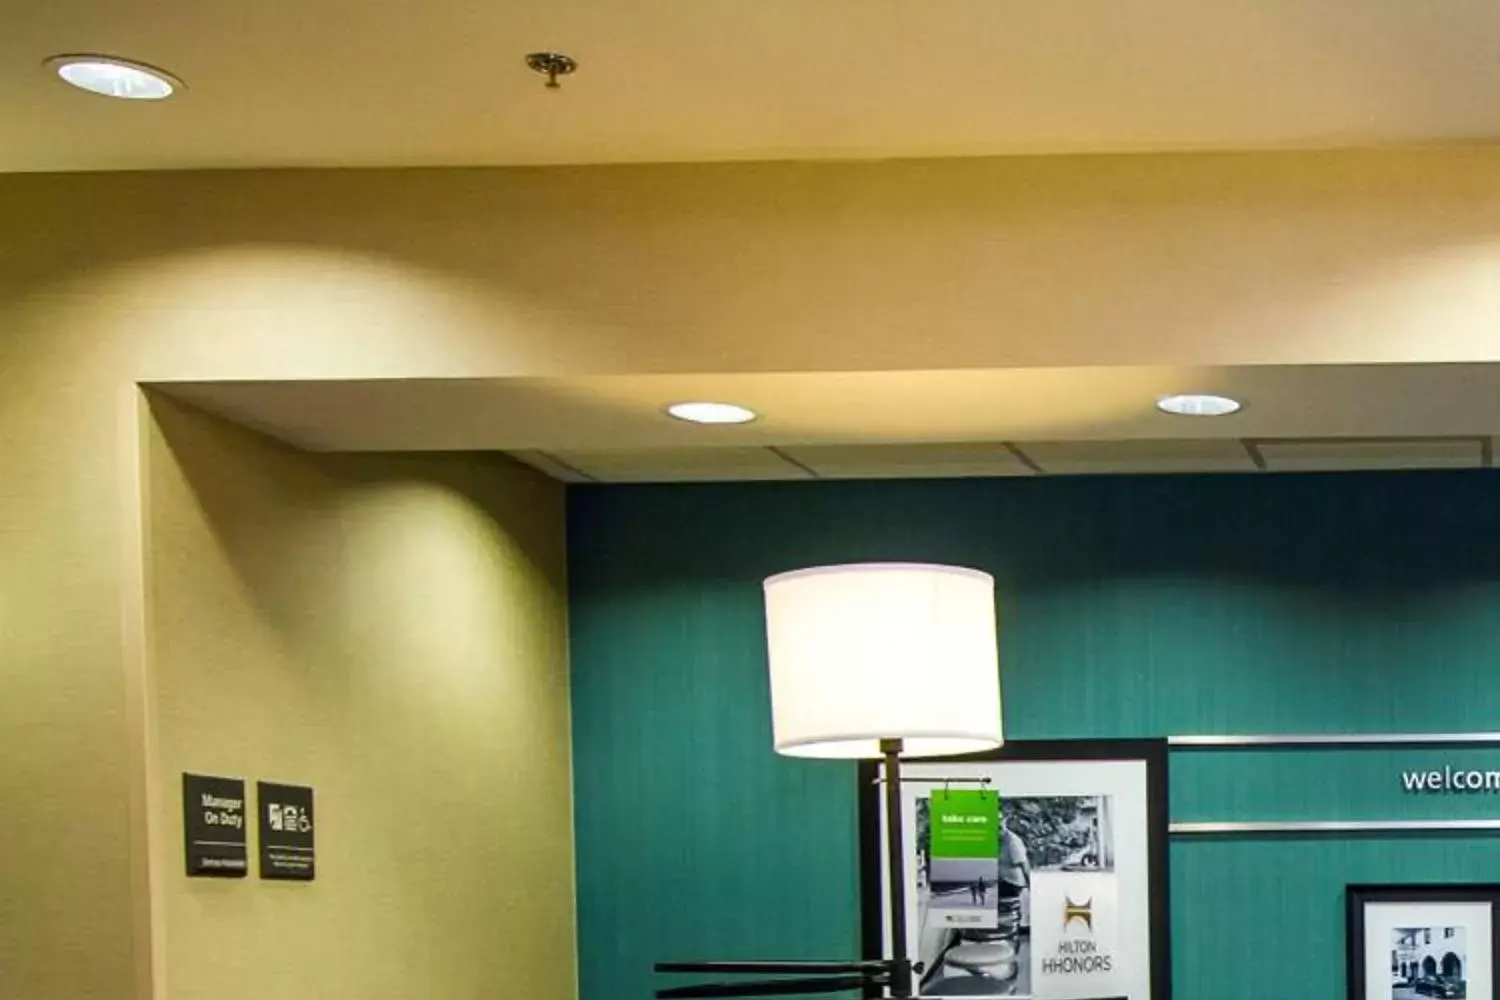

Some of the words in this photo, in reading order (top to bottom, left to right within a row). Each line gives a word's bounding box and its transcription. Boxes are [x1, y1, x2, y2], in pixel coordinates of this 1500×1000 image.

[204, 811, 219, 825] On
[219, 811, 242, 829] Duty
[1058, 940, 1097, 953] HILTON
[1041, 955, 1112, 973] HHONORS
